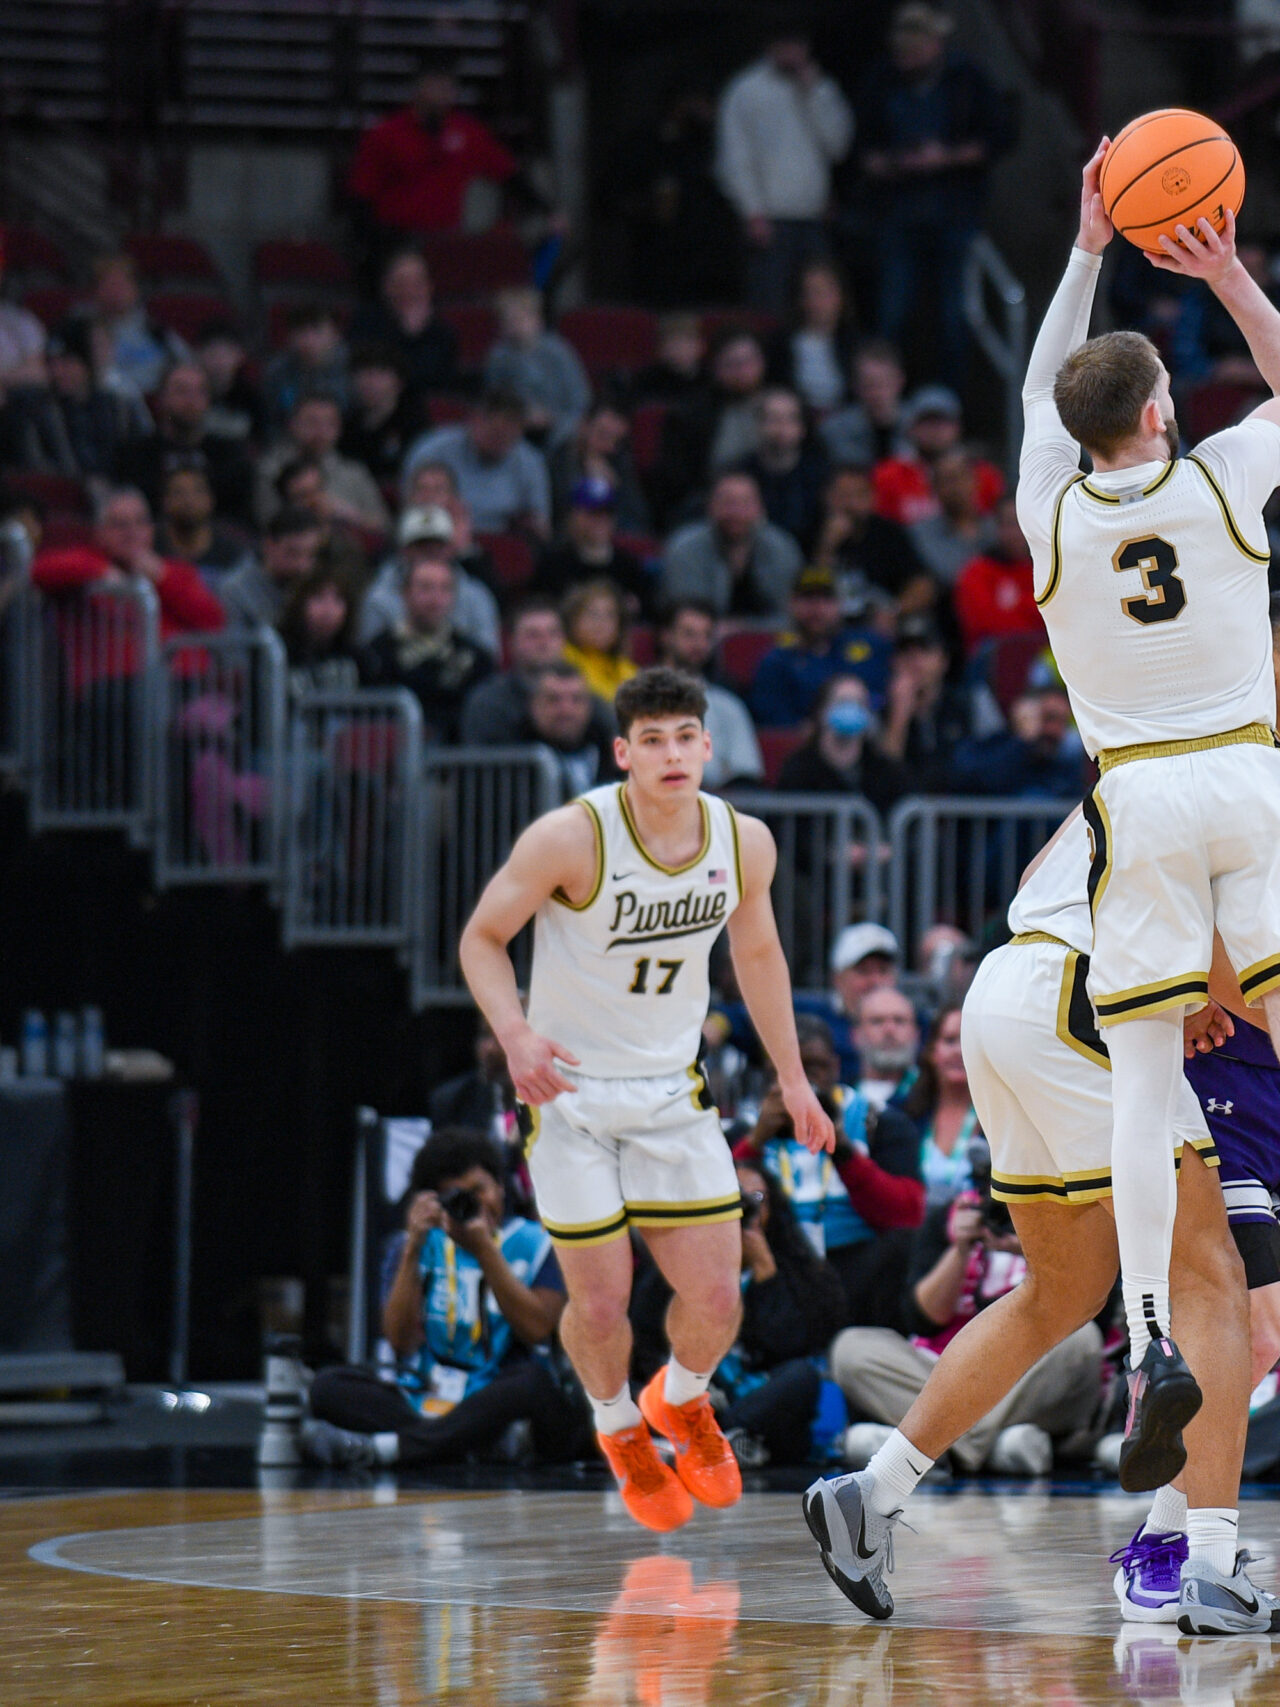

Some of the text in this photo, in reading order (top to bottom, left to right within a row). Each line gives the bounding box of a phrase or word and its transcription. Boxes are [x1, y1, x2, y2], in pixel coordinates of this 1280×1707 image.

[1111, 533, 1187, 626] 3
[608, 887, 727, 935] Purdue
[628, 957, 685, 994] 17
